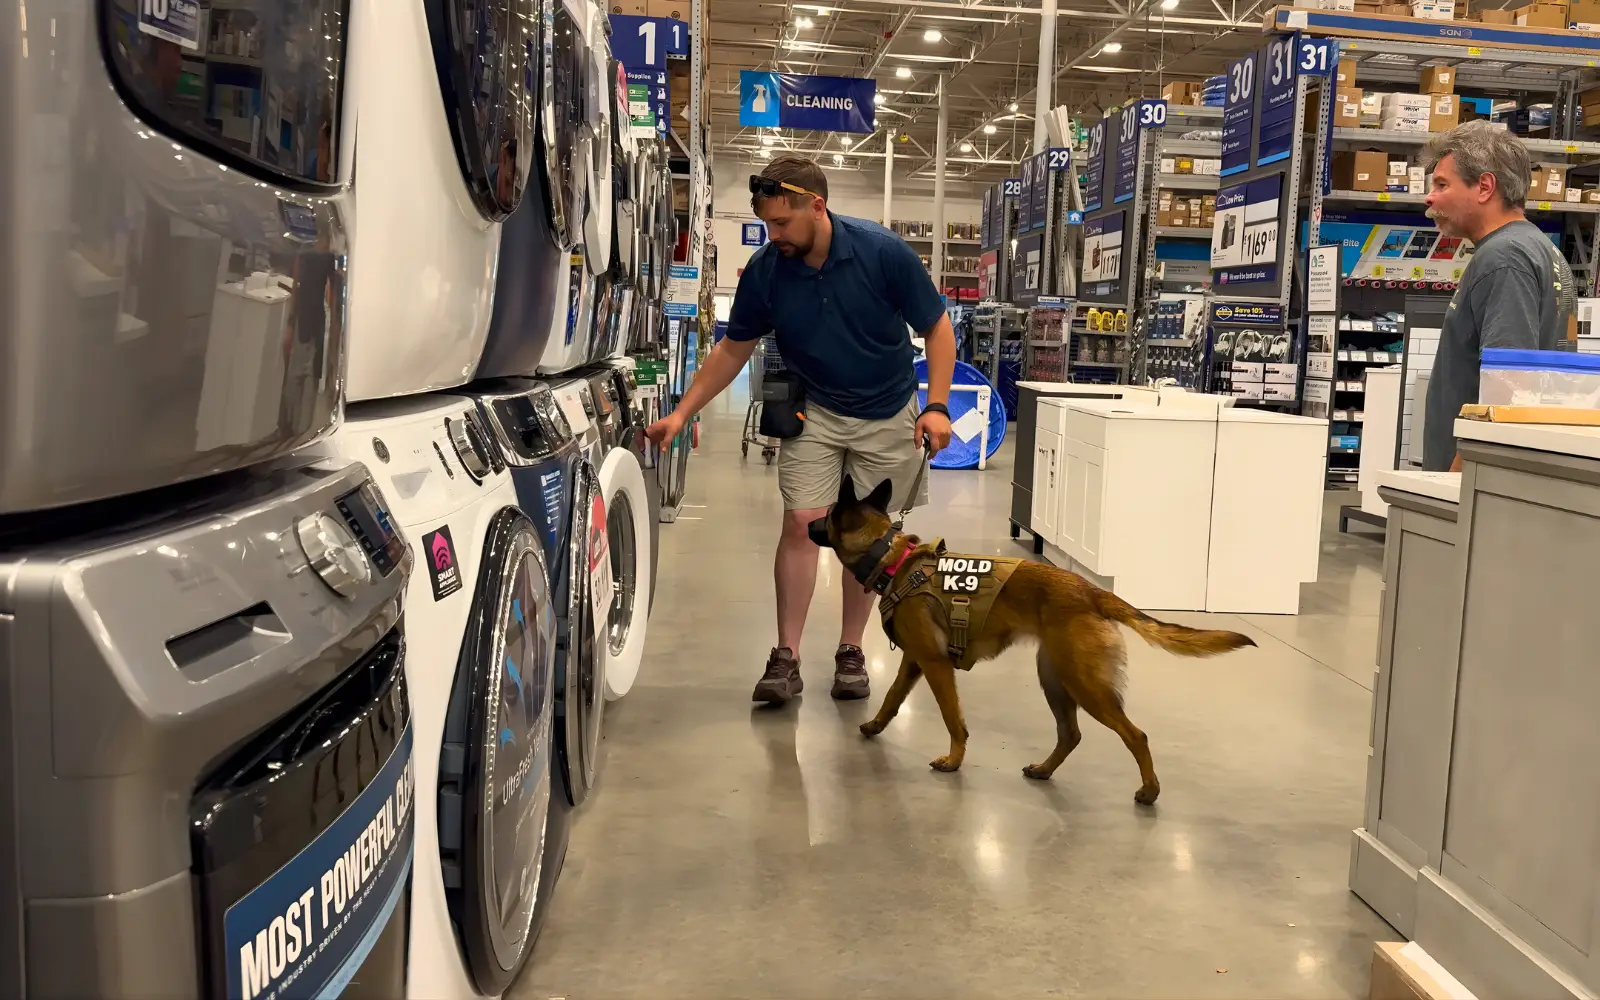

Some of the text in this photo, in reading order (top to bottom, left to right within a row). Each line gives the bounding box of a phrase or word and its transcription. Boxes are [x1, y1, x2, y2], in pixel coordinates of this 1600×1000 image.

[638, 21, 656, 65] 1
[672, 25, 680, 49] 1
[1271, 36, 1294, 86] 31
[1300, 44, 1328, 70] 31
[1230, 57, 1253, 104] 30
[786, 94, 853, 111] CLEANING
[1140, 103, 1167, 124] 30
[1121, 105, 1136, 143] 30
[1088, 123, 1103, 159] 29
[1035, 153, 1047, 182] 29
[1049, 150, 1069, 167] 29
[1022, 160, 1032, 188] 28
[1004, 180, 1021, 196] 28
[437, 566, 455, 582] SMART
[937, 558, 992, 573] MOLD
[943, 575, 979, 591] K-9
[240, 886, 315, 1000] MOST
[321, 794, 396, 929] POWERFUL
